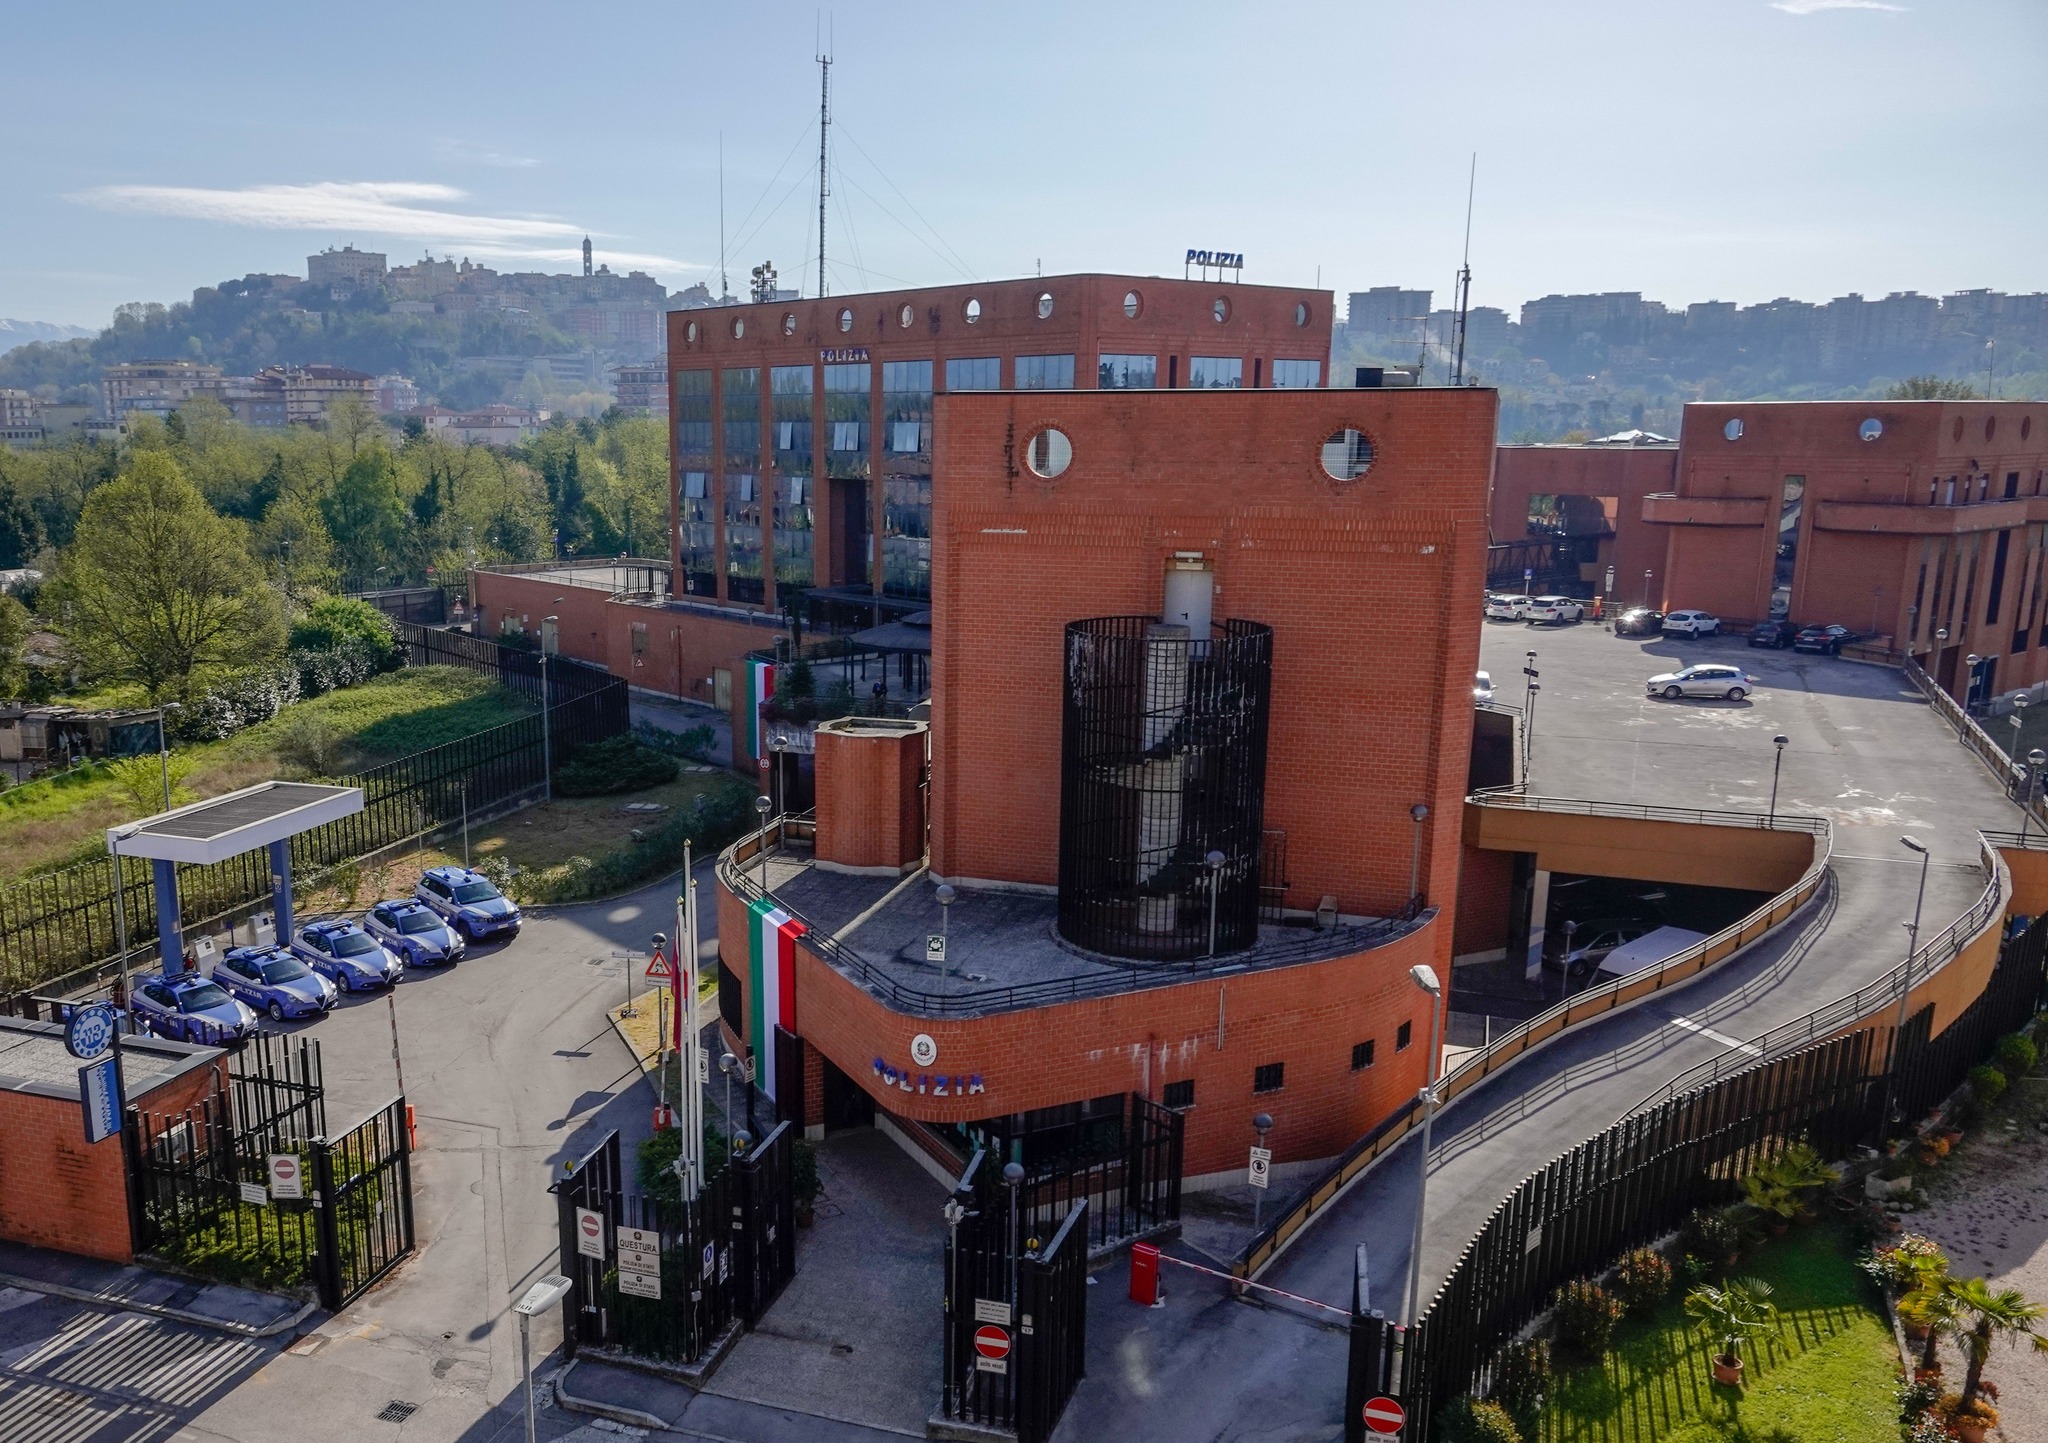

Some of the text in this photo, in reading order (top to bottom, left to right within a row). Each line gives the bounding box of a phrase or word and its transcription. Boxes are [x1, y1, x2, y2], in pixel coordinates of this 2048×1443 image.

[1185, 249, 1243, 269] POLIZIA
[820, 349, 869, 362] POLIZIA
[228, 982, 263, 1000] POLIZIA
[82, 1023, 102, 1045] 113
[872, 1057, 985, 1097] POLIZIA
[620, 1239, 657, 1253] QUESTURA
